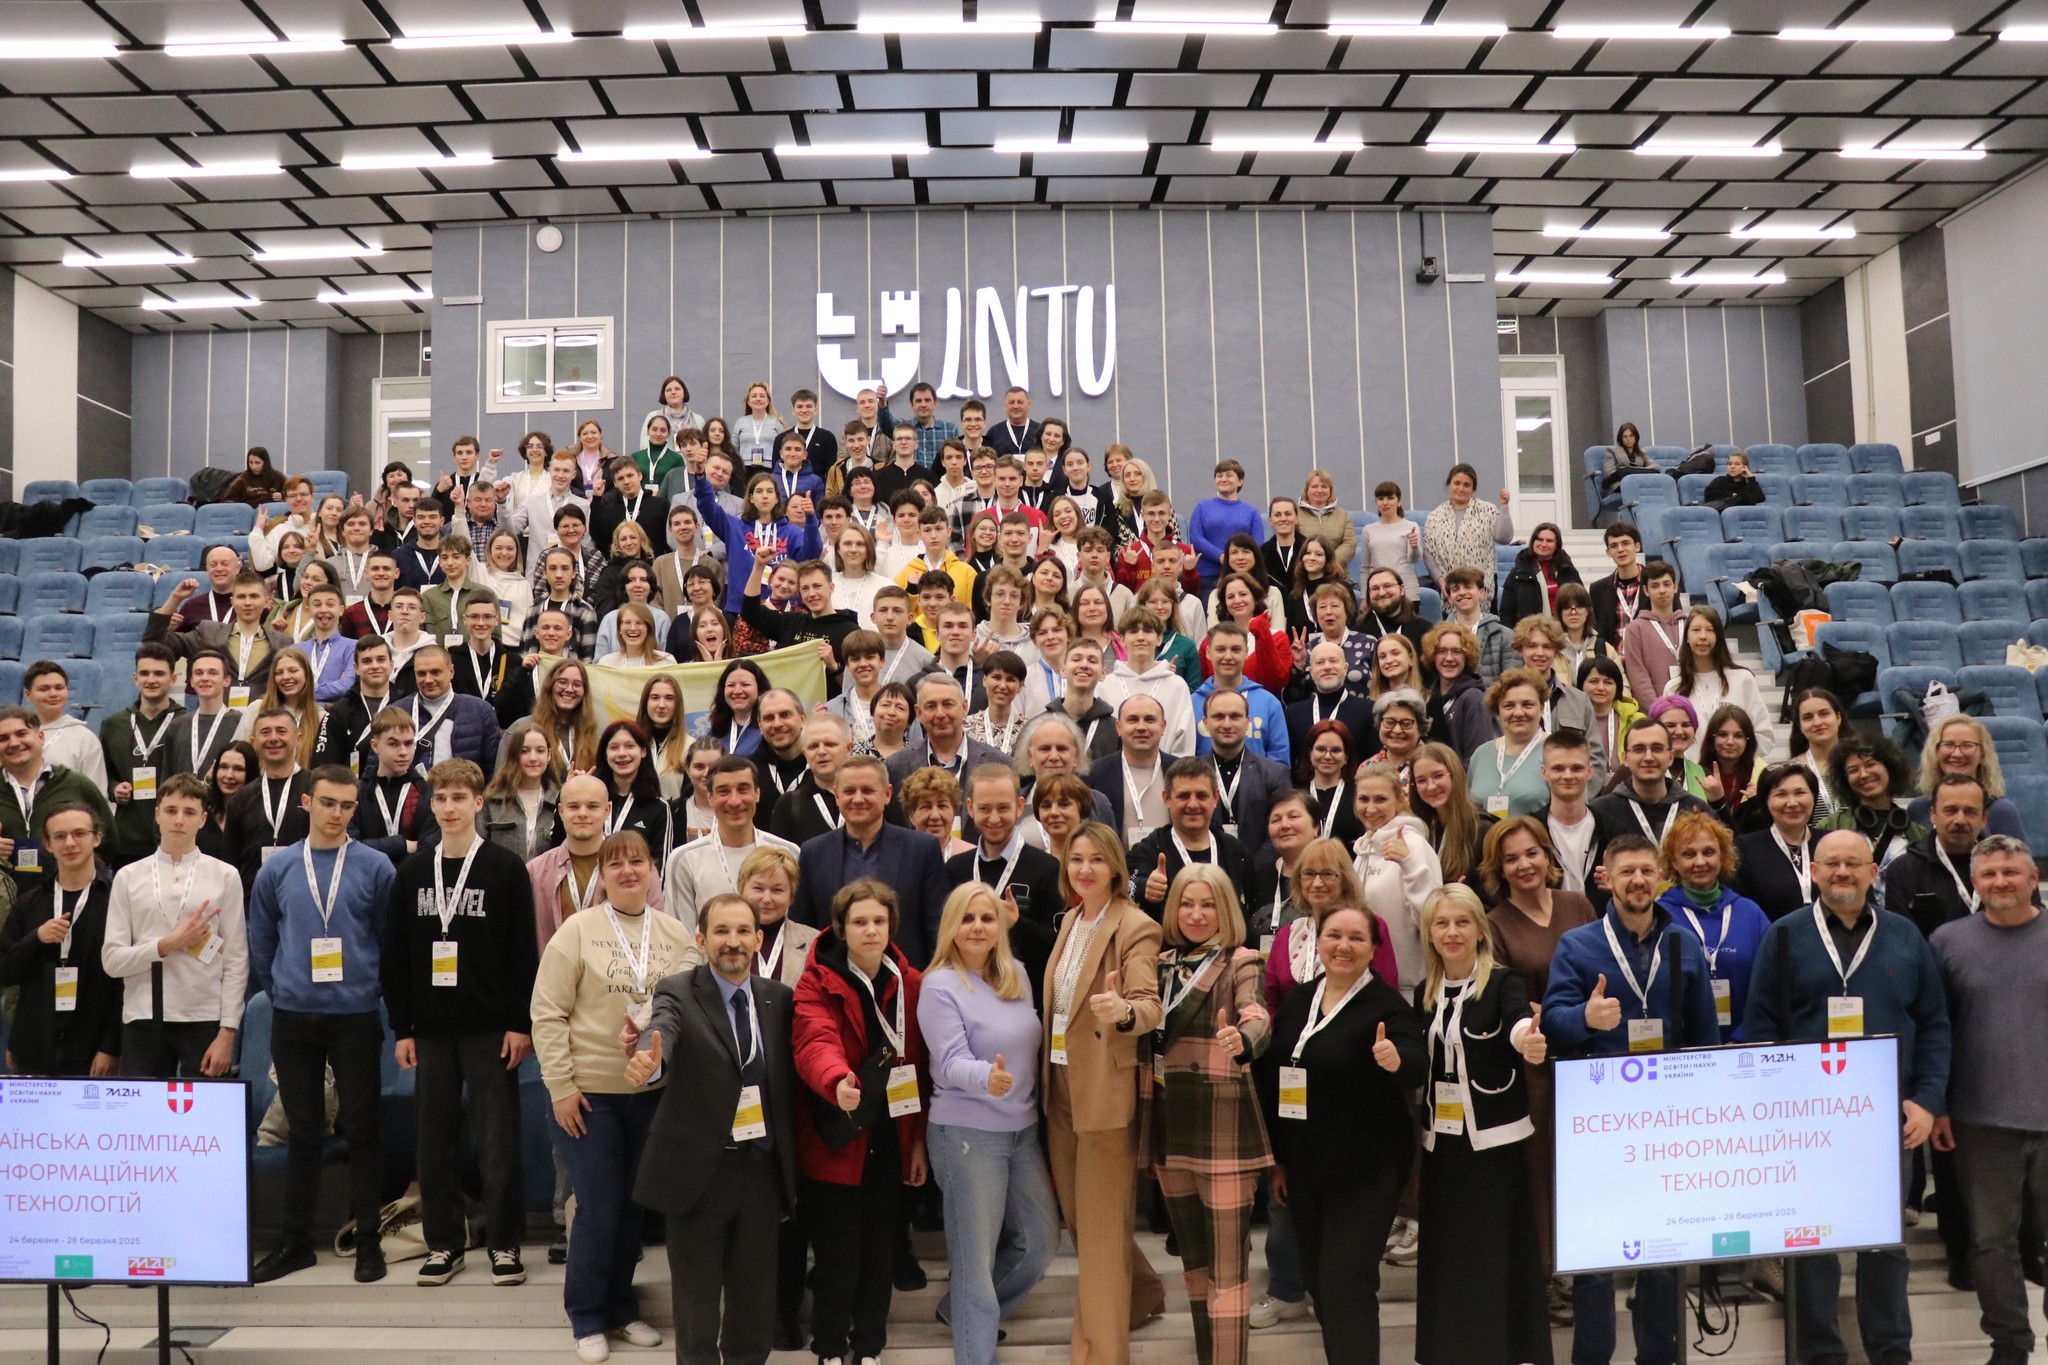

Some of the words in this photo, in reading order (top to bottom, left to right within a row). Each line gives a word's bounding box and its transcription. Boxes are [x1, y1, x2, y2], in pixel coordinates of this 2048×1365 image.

[936, 284, 1116, 399] LNTU
[417, 887, 487, 917] MRVEL
[630, 942, 656, 951] GIE
[1663, 1053, 1712, 1062] МІНІСТЕРСТВО
[1664, 1071, 1694, 1079] УКРАЇНИ
[1572, 1104, 1746, 1134] ВСЕУКРАЇНСЬКА
[1752, 1095, 1874, 1120] ОЛІМПІАДА
[97, 1133, 221, 1156] ОЛІМПІАДА
[1623, 1144, 1636, 1163] З
[1643, 1128, 1832, 1161] ІНФОРМАЦІЙНИХ
[1660, 1160, 1797, 1192] ТЕХНОЛОГІЙ
[4, 1191, 141, 1213] ТЕХНОЛОГІЙ
[1666, 1217, 1677, 1225] 24
[1678, 1214, 1716, 1225] березня
[1724, 1213, 1734, 1221] 28
[1736, 1210, 1773, 1221] березня
[1775, 1208, 1797, 1217] 2025
[8, 1236, 19, 1244] 24
[21, 1236, 59, 1246] березня
[67, 1236, 78, 1244] 28
[79, 1236, 117, 1246] березня
[119, 1237, 141, 1245] 2025
